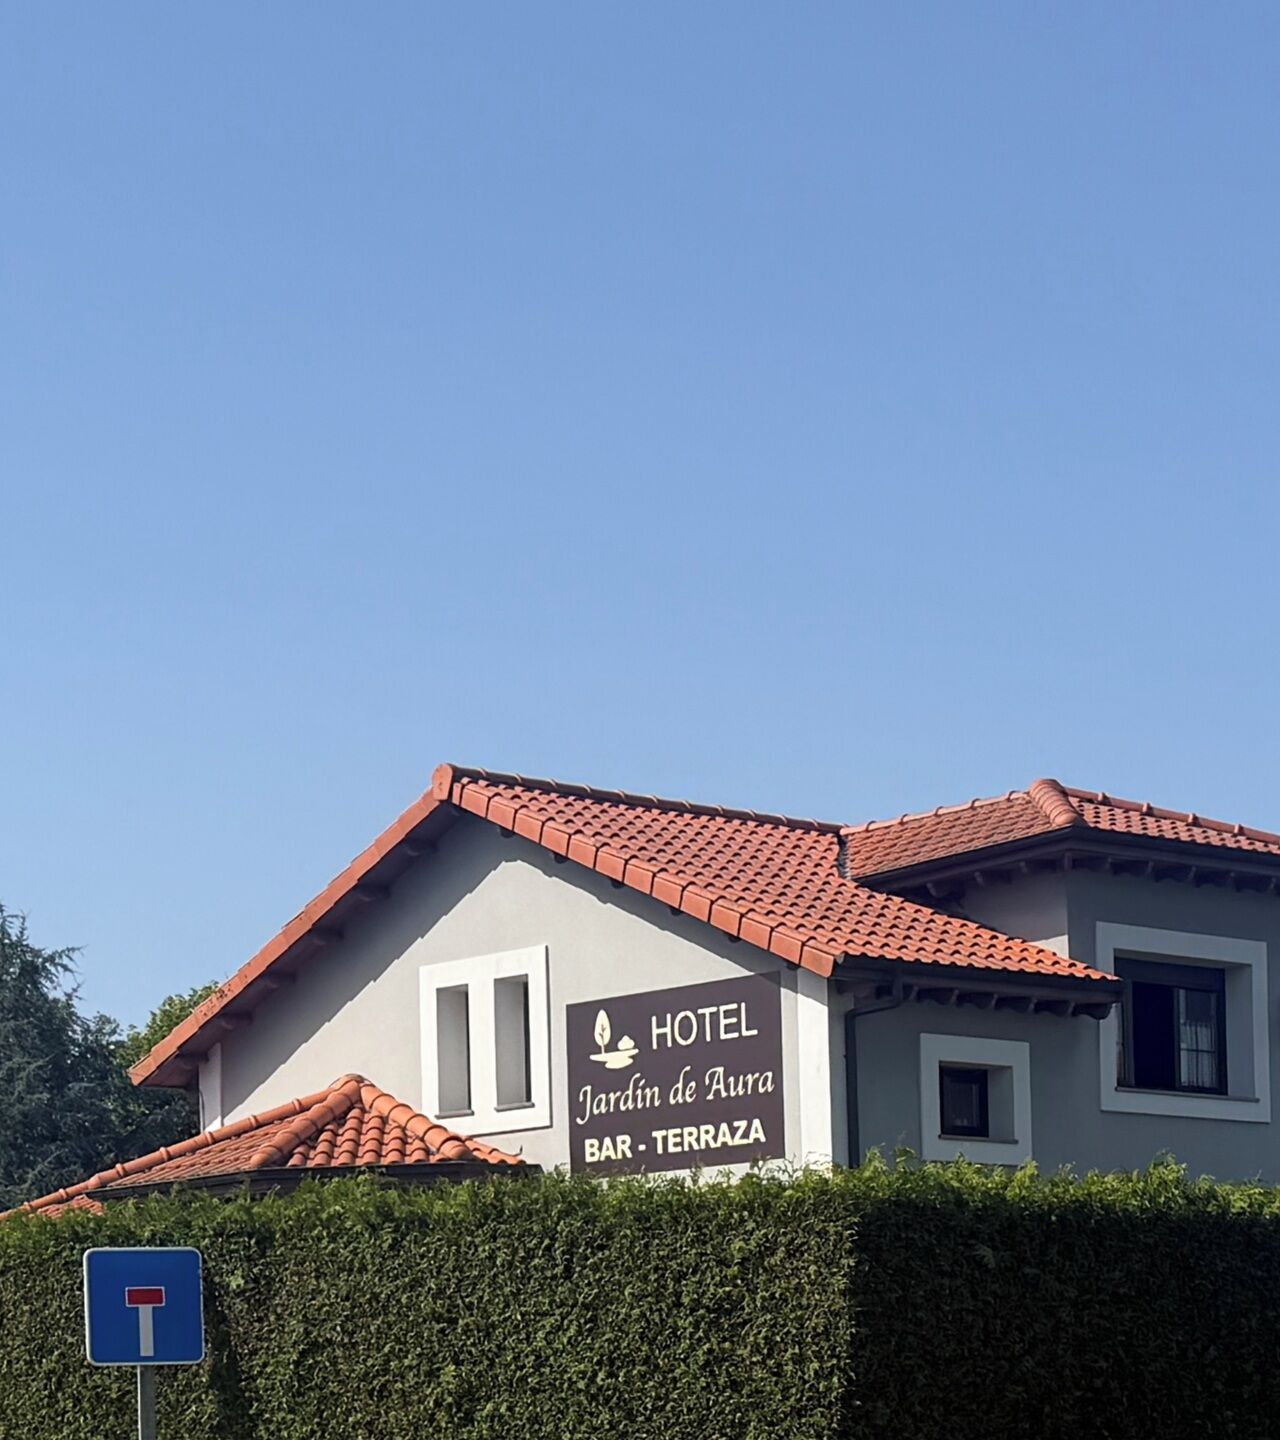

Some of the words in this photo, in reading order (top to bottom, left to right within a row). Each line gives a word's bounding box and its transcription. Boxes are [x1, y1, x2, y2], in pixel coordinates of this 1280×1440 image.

[651, 1002, 758, 1050] HOTEL
[576, 1073, 661, 1125] Jardín
[669, 1065, 697, 1105] de
[705, 1066, 775, 1101] Aura
[584, 1134, 632, 1163] BAR
[652, 1118, 766, 1154] TERRAZA
